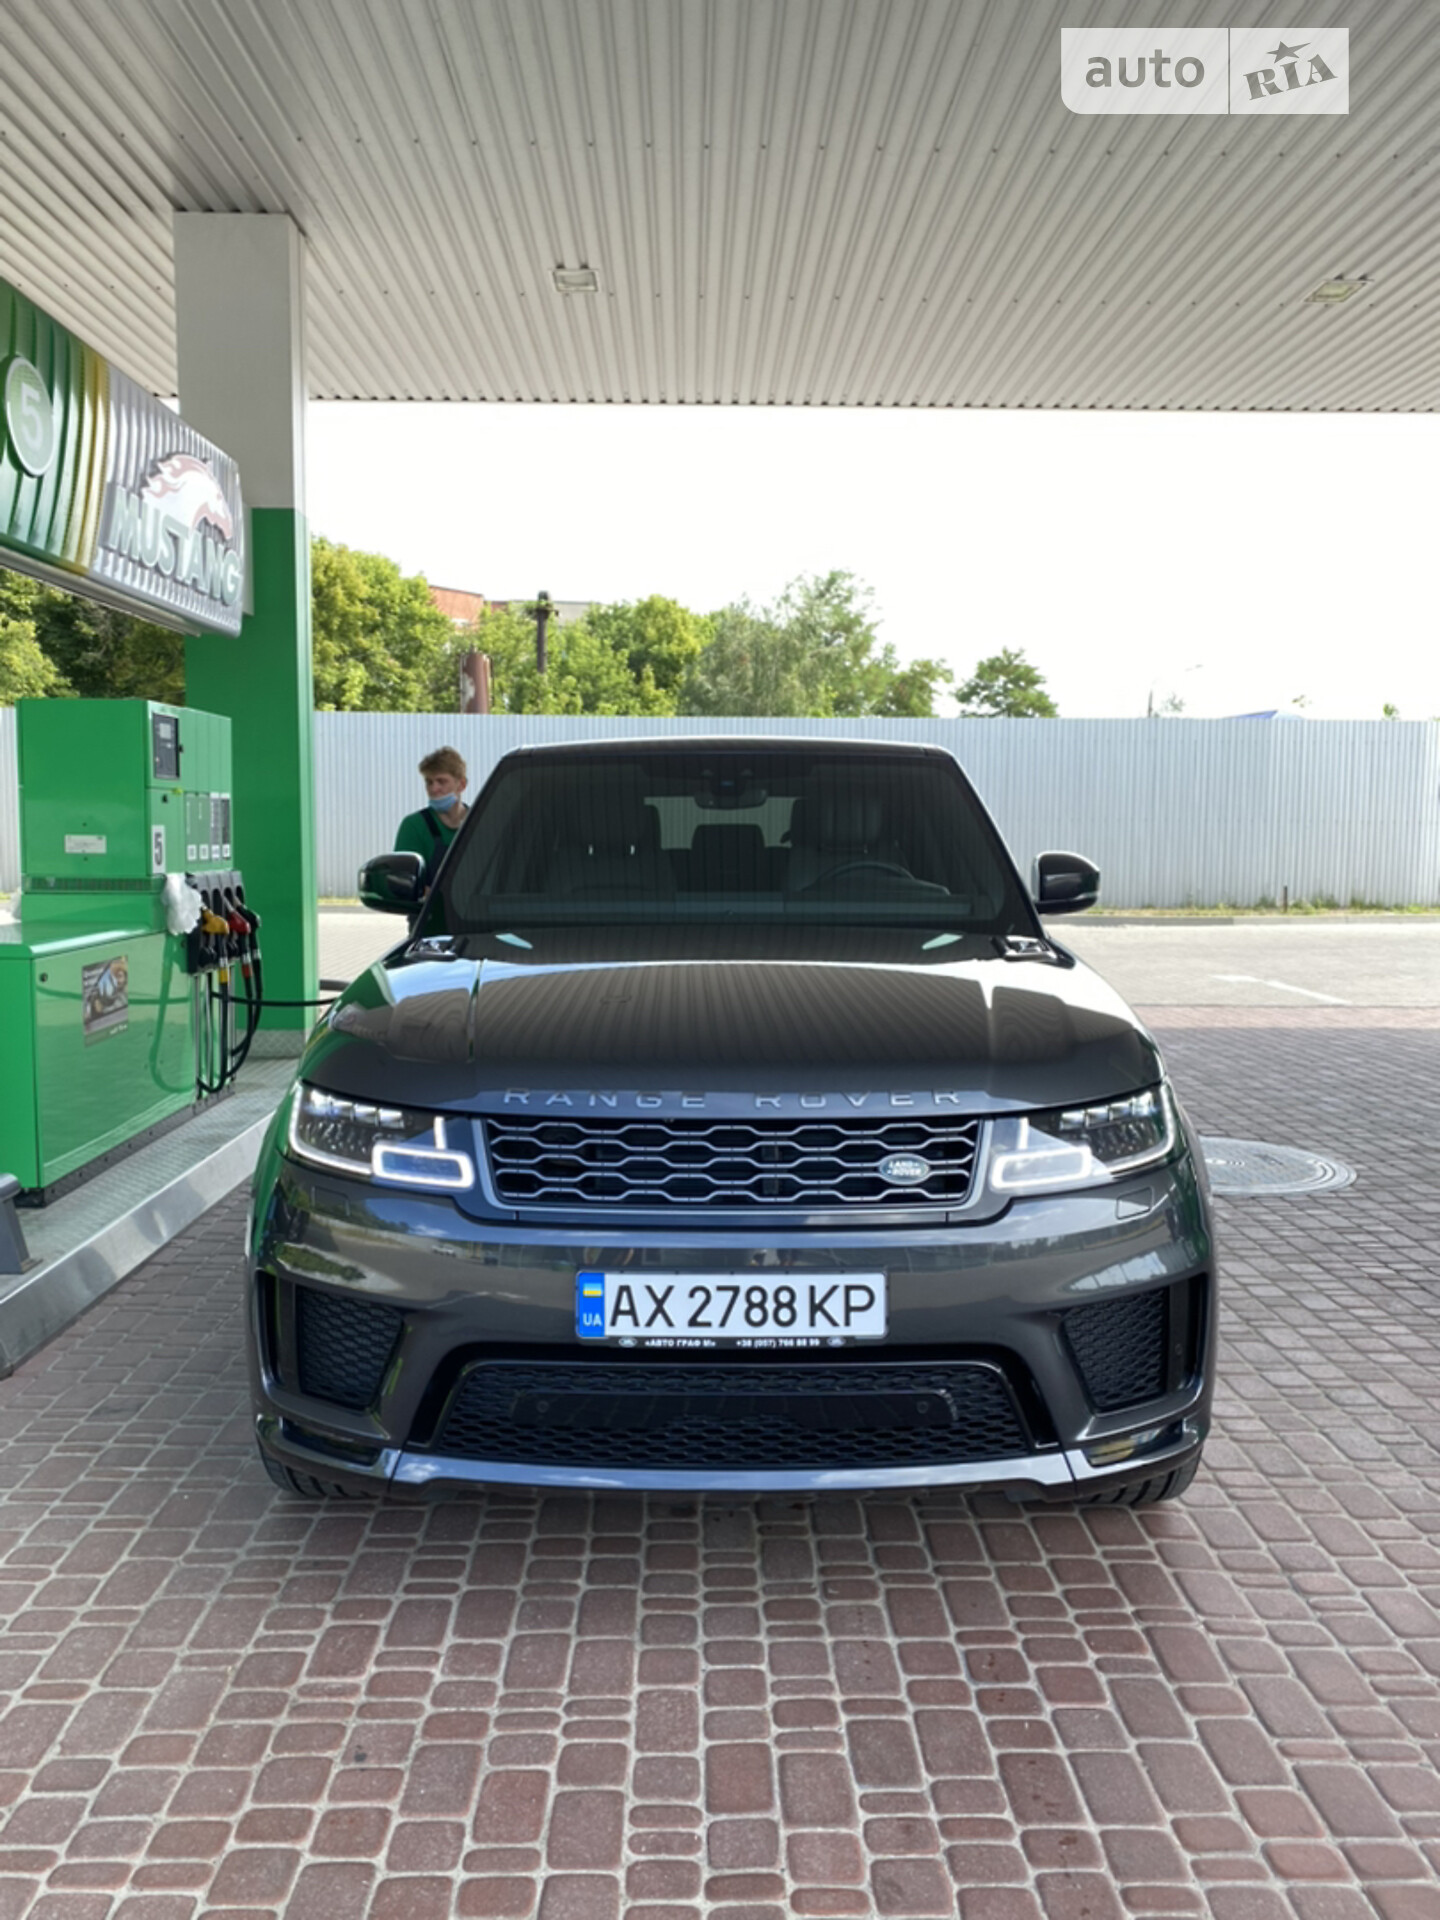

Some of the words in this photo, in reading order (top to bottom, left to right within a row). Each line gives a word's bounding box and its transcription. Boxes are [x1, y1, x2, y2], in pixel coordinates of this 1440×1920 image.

[21, 382, 43, 450] 5
[109, 485, 242, 606] MUSTANG
[154, 832, 163, 866] 5
[504, 1087, 706, 1109] RANGE
[755, 1088, 961, 1109] ROVER
[583, 1313, 602, 1326] UA
[610, 1285, 674, 1327] AX
[687, 1285, 797, 1328] 2788
[809, 1285, 876, 1327] KP
